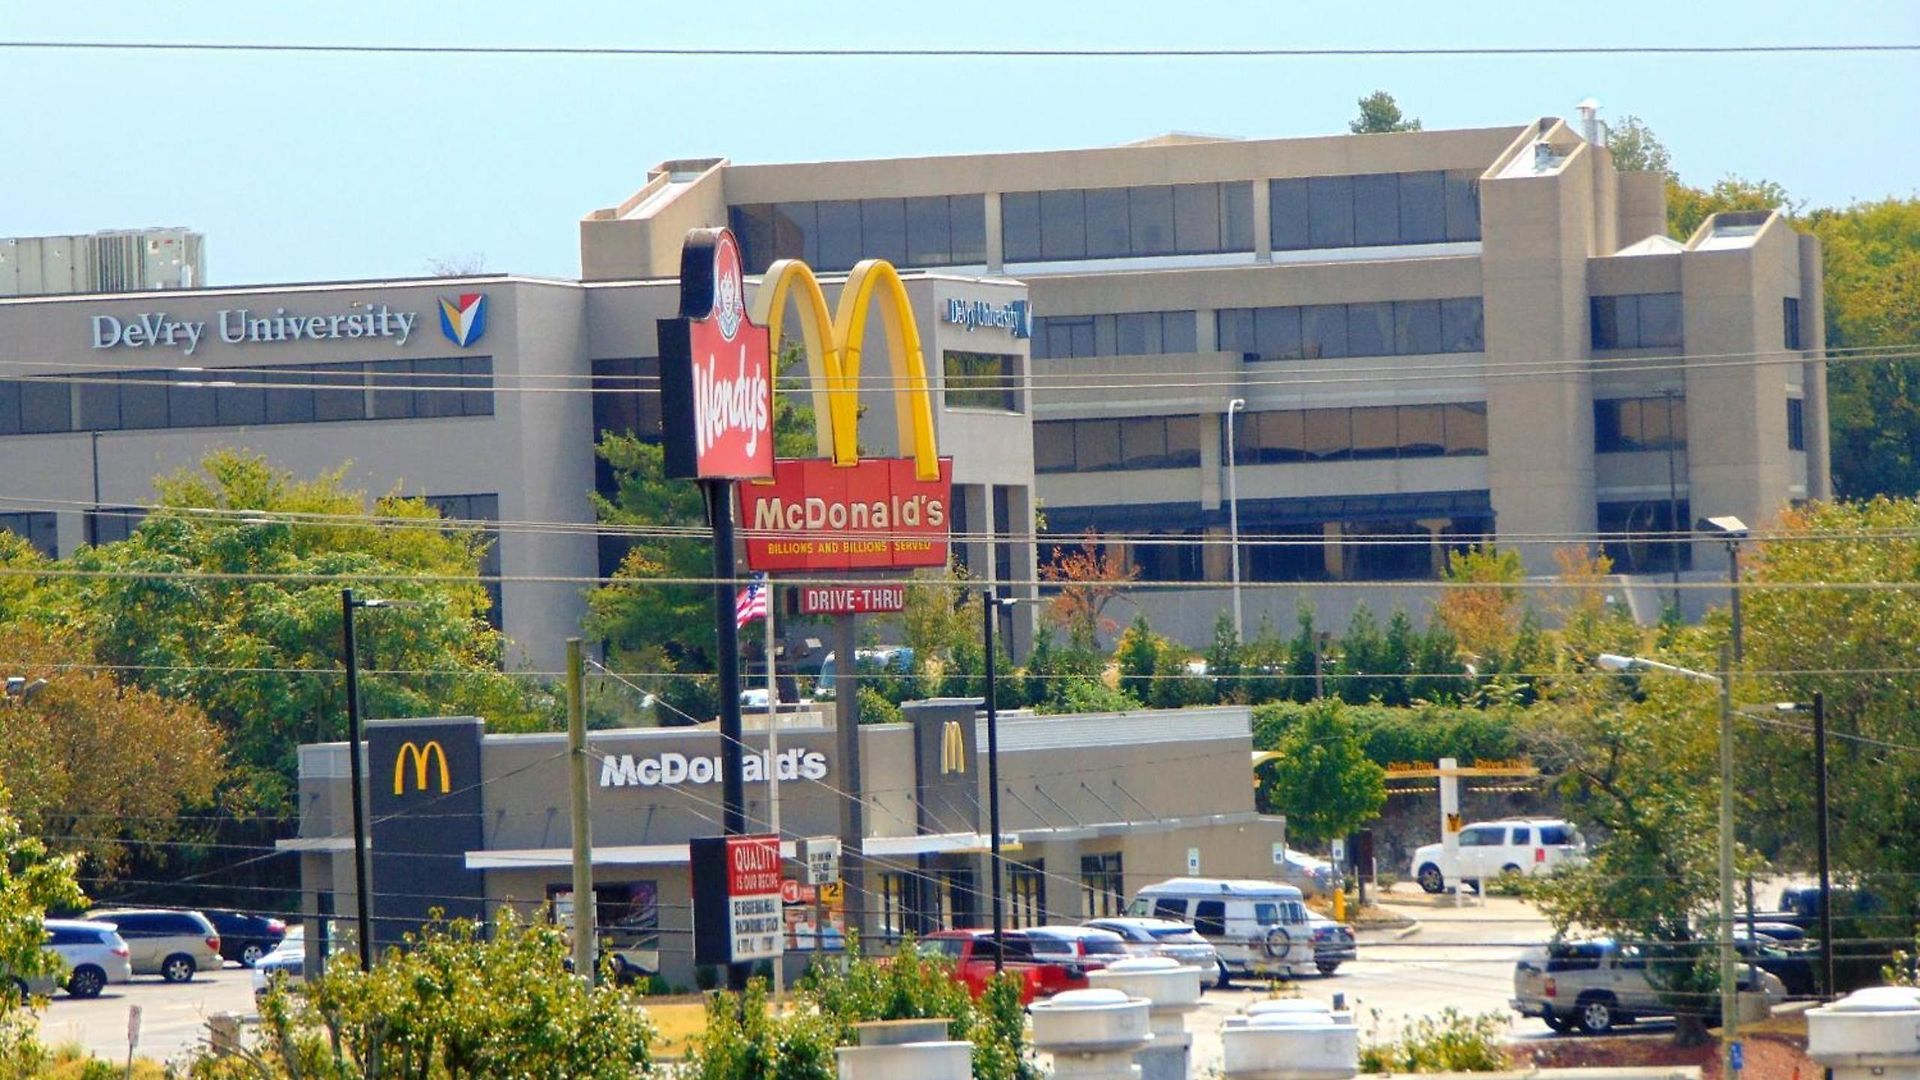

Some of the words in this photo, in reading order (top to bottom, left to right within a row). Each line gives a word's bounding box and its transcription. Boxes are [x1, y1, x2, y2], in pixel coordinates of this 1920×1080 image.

[91, 312, 205, 356] DeVry
[219, 303, 417, 346] University
[693, 343, 768, 458] Wendy's
[754, 495, 944, 531] McDonald's
[768, 542, 813, 555] BILLIONS
[817, 541, 839, 554] AND
[843, 541, 887, 553] BILLIONS
[894, 540, 932, 552] SERVED
[808, 589, 904, 611] DRIVE-THRU
[735, 844, 778, 873] QUALITY
[736, 875, 743, 890] IS
[744, 874, 757, 890] OUR
[758, 872, 779, 888] RECIPE
